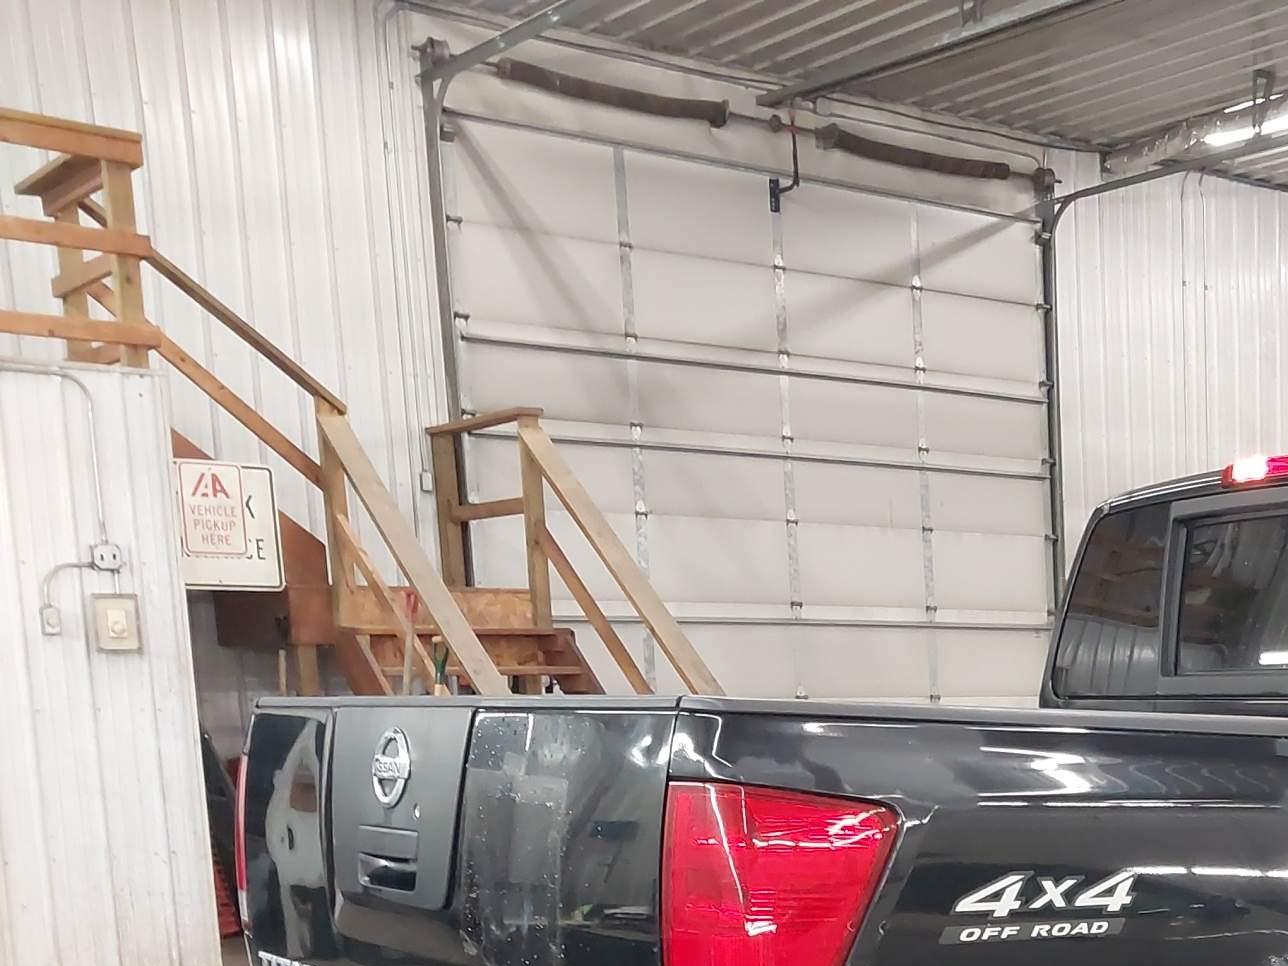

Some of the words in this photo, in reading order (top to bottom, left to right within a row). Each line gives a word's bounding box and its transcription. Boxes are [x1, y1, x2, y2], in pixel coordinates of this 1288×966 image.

[189, 504, 238, 517] VEHICLE
[193, 519, 237, 531] PICKUP
[201, 533, 232, 546] HERE
[959, 926, 1020, 942] OFF
[1031, 921, 1109, 938] ROAD
